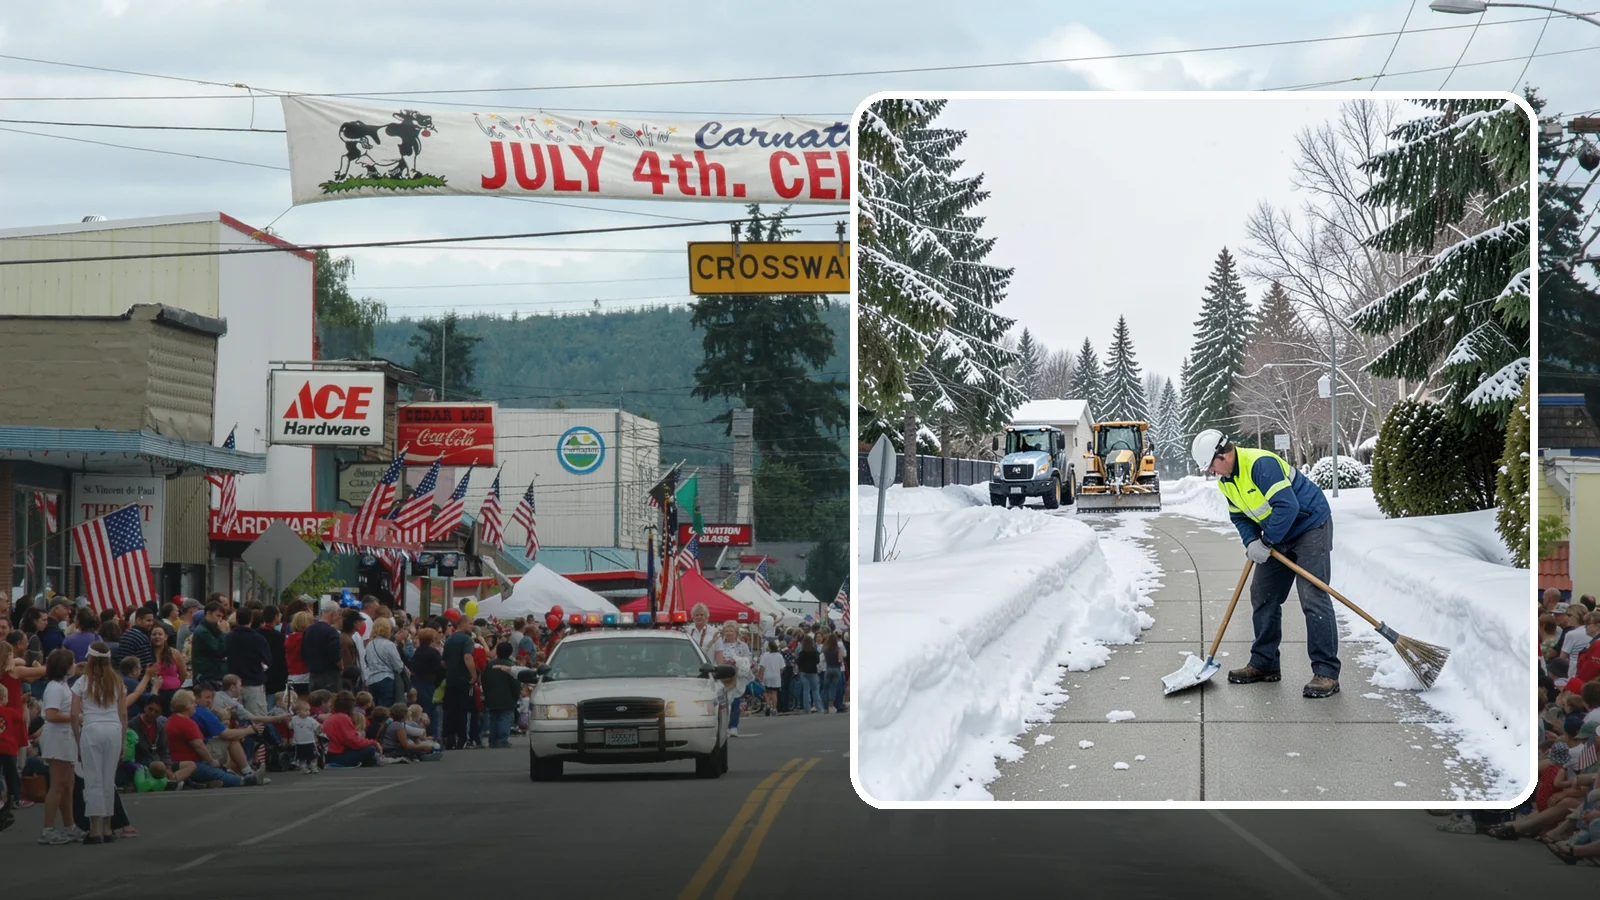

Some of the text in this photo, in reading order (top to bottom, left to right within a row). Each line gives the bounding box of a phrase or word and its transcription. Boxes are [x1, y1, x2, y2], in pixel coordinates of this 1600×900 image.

[695, 121, 850, 150] Carnat
[481, 141, 605, 193] JULY
[632, 150, 746, 198] 4th.
[697, 254, 850, 280] CROSSWA
[282, 380, 373, 420] ACE
[406, 409, 452, 422] CEDAR
[283, 421, 371, 437] Hardware
[416, 428, 477, 447] Coca-Cola
[353, 467, 384, 480] Simpl
[95, 485, 124, 495] Vincent
[126, 486, 136, 495] de
[137, 486, 155, 495] Paul
[81, 503, 154, 522] THRT
[212, 516, 331, 535] HARDARE
[688, 526, 741, 535] CRNATION
[699, 535, 730, 543] GLASS
